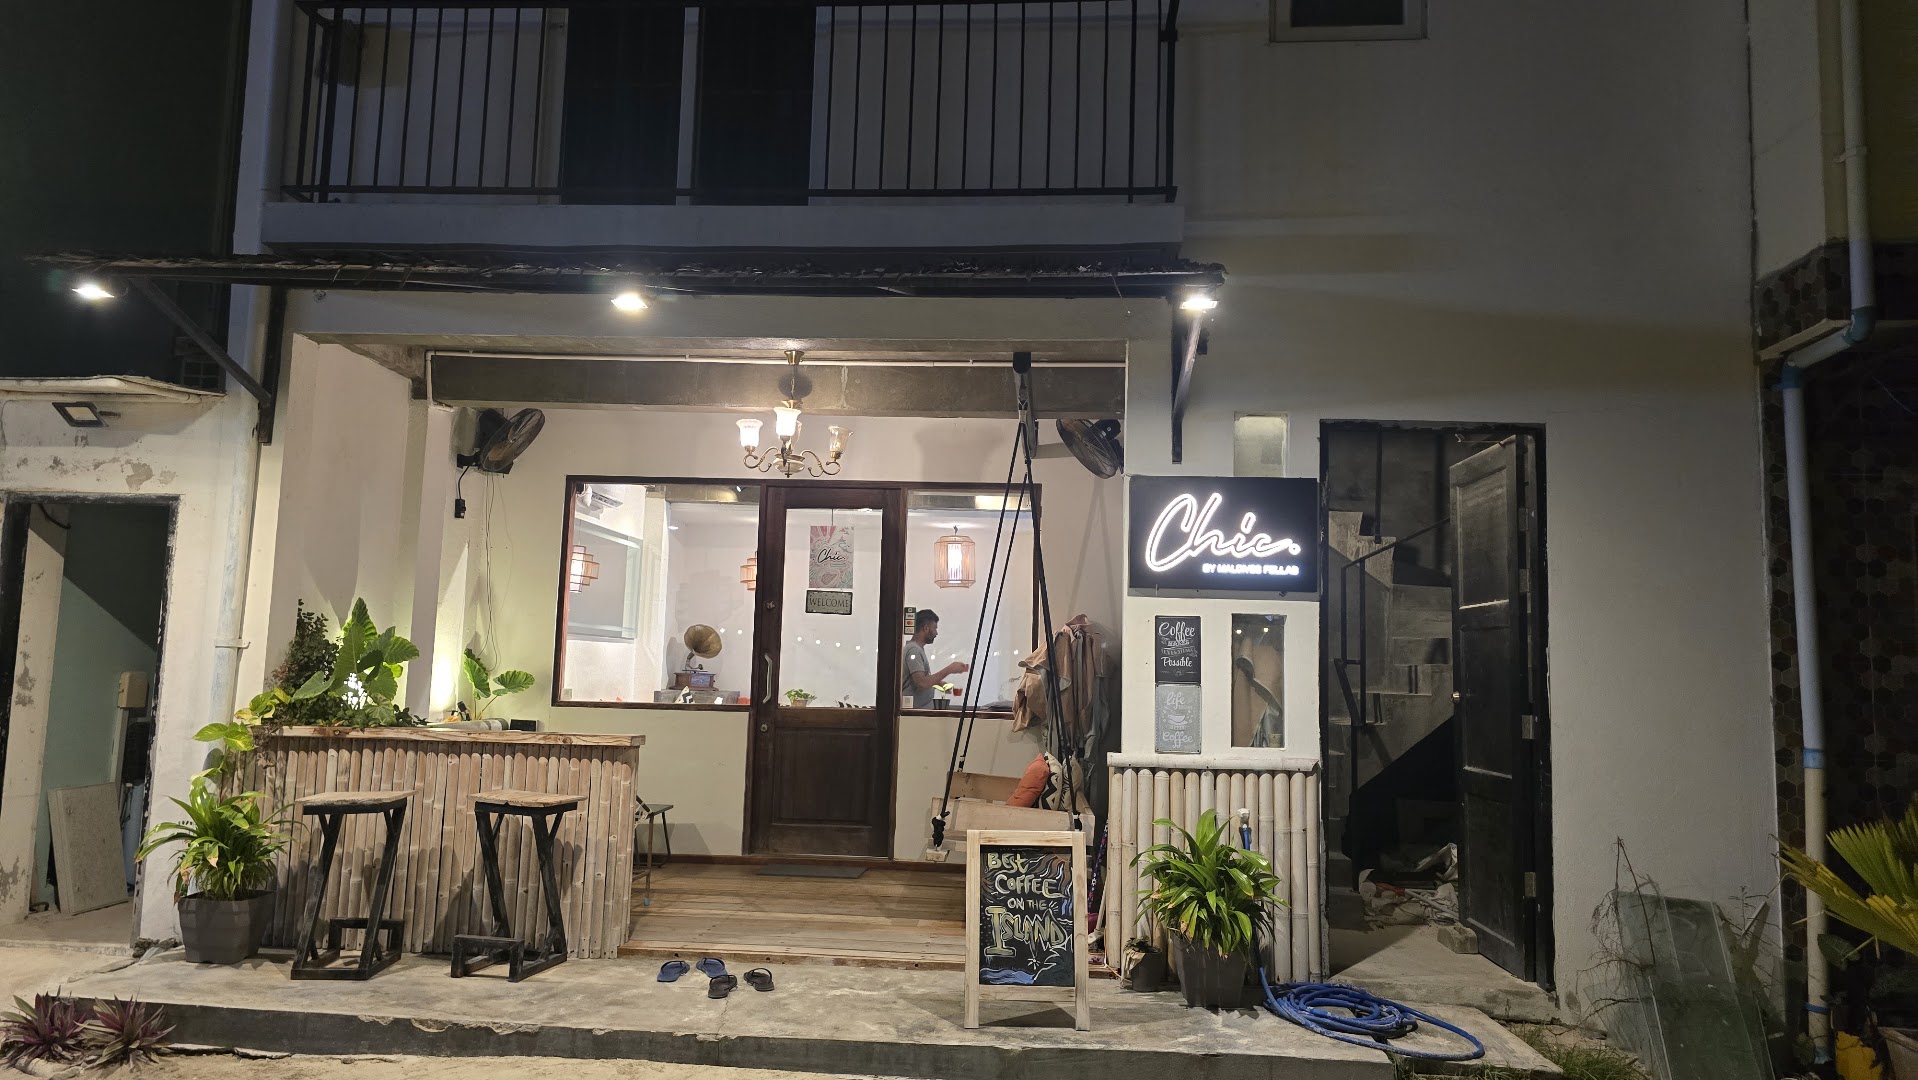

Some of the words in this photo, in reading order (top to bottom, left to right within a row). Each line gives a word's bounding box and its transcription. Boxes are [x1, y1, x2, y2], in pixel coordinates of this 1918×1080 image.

[809, 597, 850, 608] WELCOME
[1158, 620, 1196, 642] Coffee
[1160, 656, 1193, 668] Possible
[1007, 897, 1025, 911] ON
[1026, 899, 1048, 911] THE
